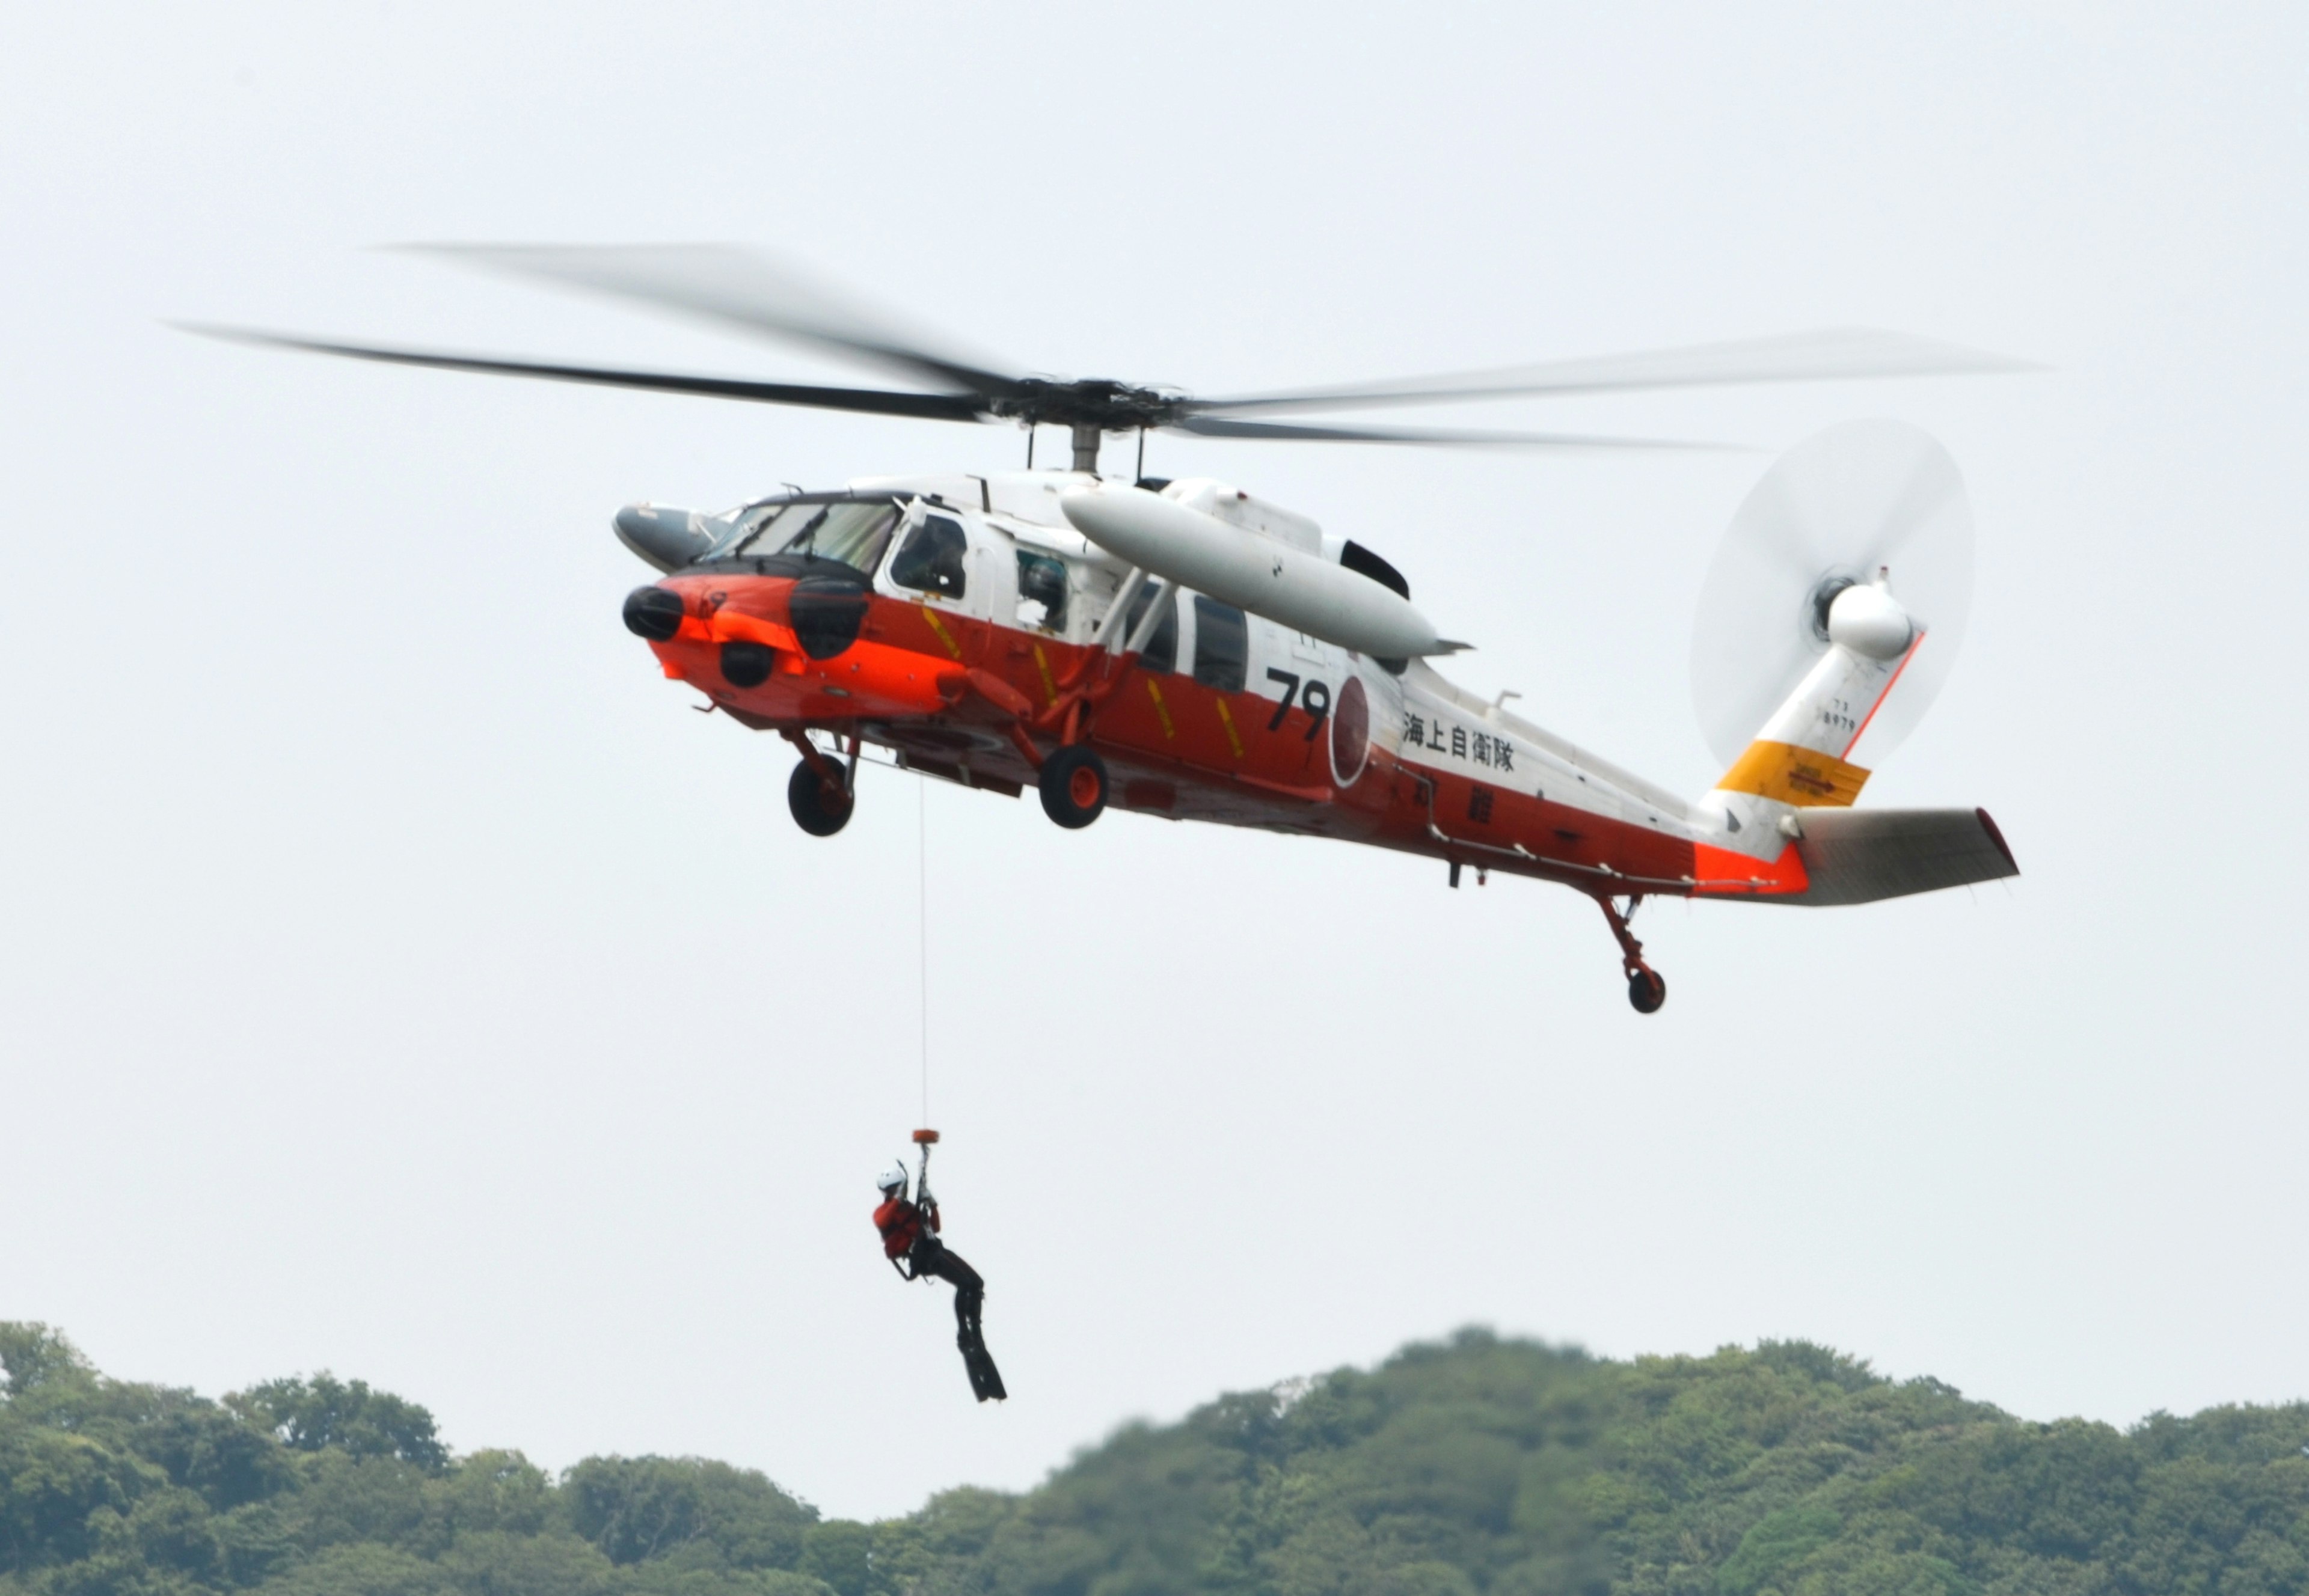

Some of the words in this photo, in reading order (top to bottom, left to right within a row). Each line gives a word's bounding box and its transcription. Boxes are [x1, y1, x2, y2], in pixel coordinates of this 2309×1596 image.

[1267, 666, 1331, 742] 79
[1824, 711, 1855, 733] 8979
[1403, 711, 1514, 772] 海上自衛隊
